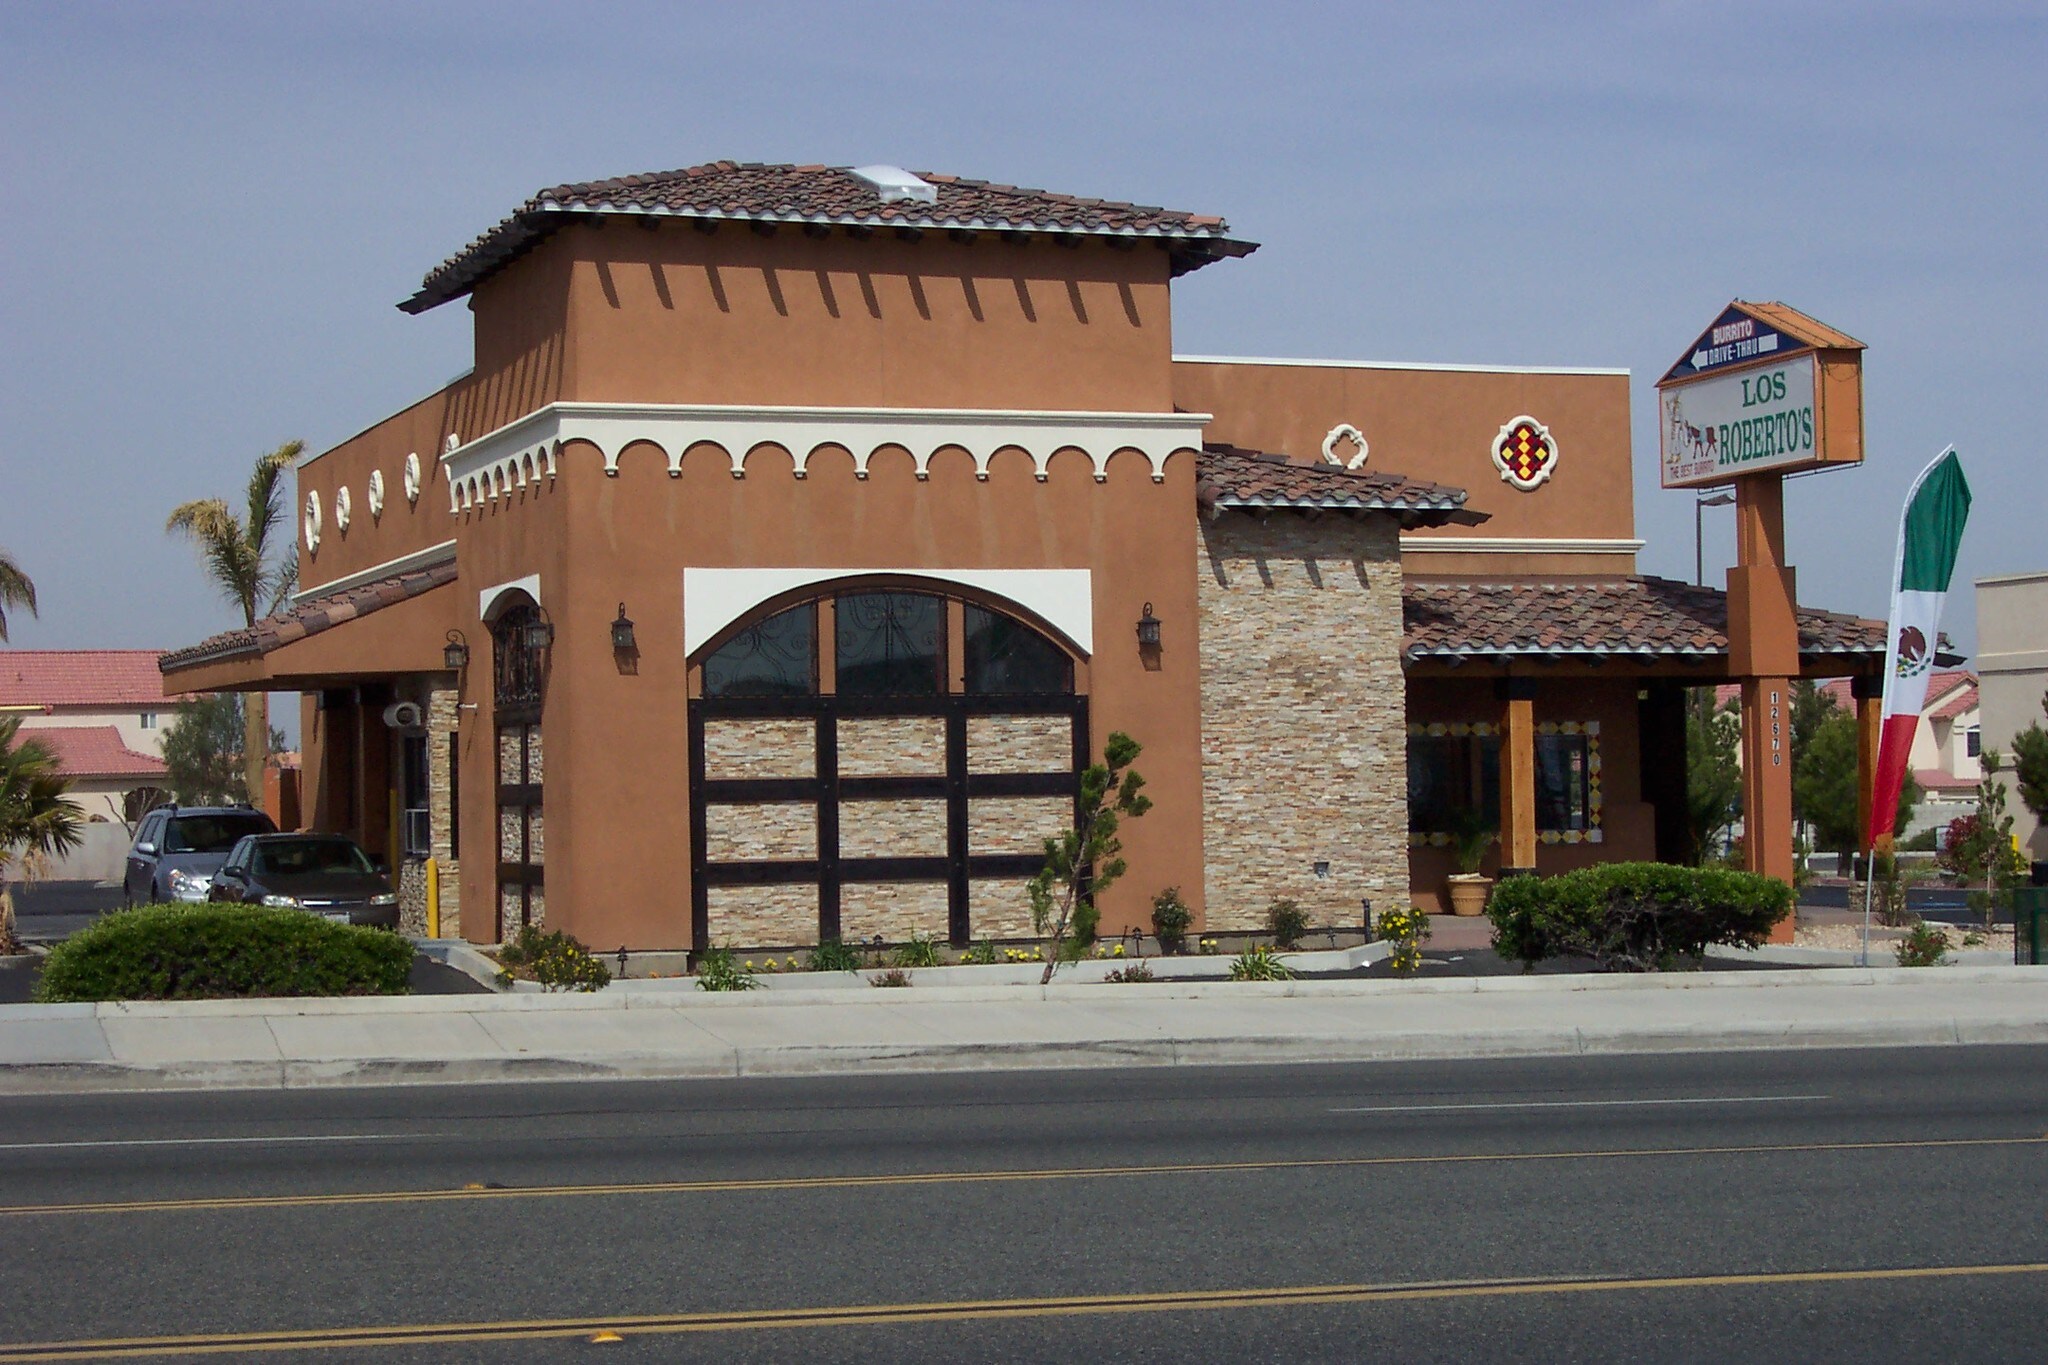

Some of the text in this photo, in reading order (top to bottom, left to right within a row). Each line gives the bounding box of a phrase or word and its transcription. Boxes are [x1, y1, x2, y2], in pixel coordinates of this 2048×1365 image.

[1713, 320, 1753, 345] BURRITO
[1709, 337, 1758, 365] DRIVE-THRU
[1741, 371, 1786, 408] LOS
[1719, 406, 1812, 465] ROBERTO'S
[1670, 466, 1679, 479] THE
[1680, 463, 1693, 477] BEST
[1771, 692, 1780, 765] 12670
